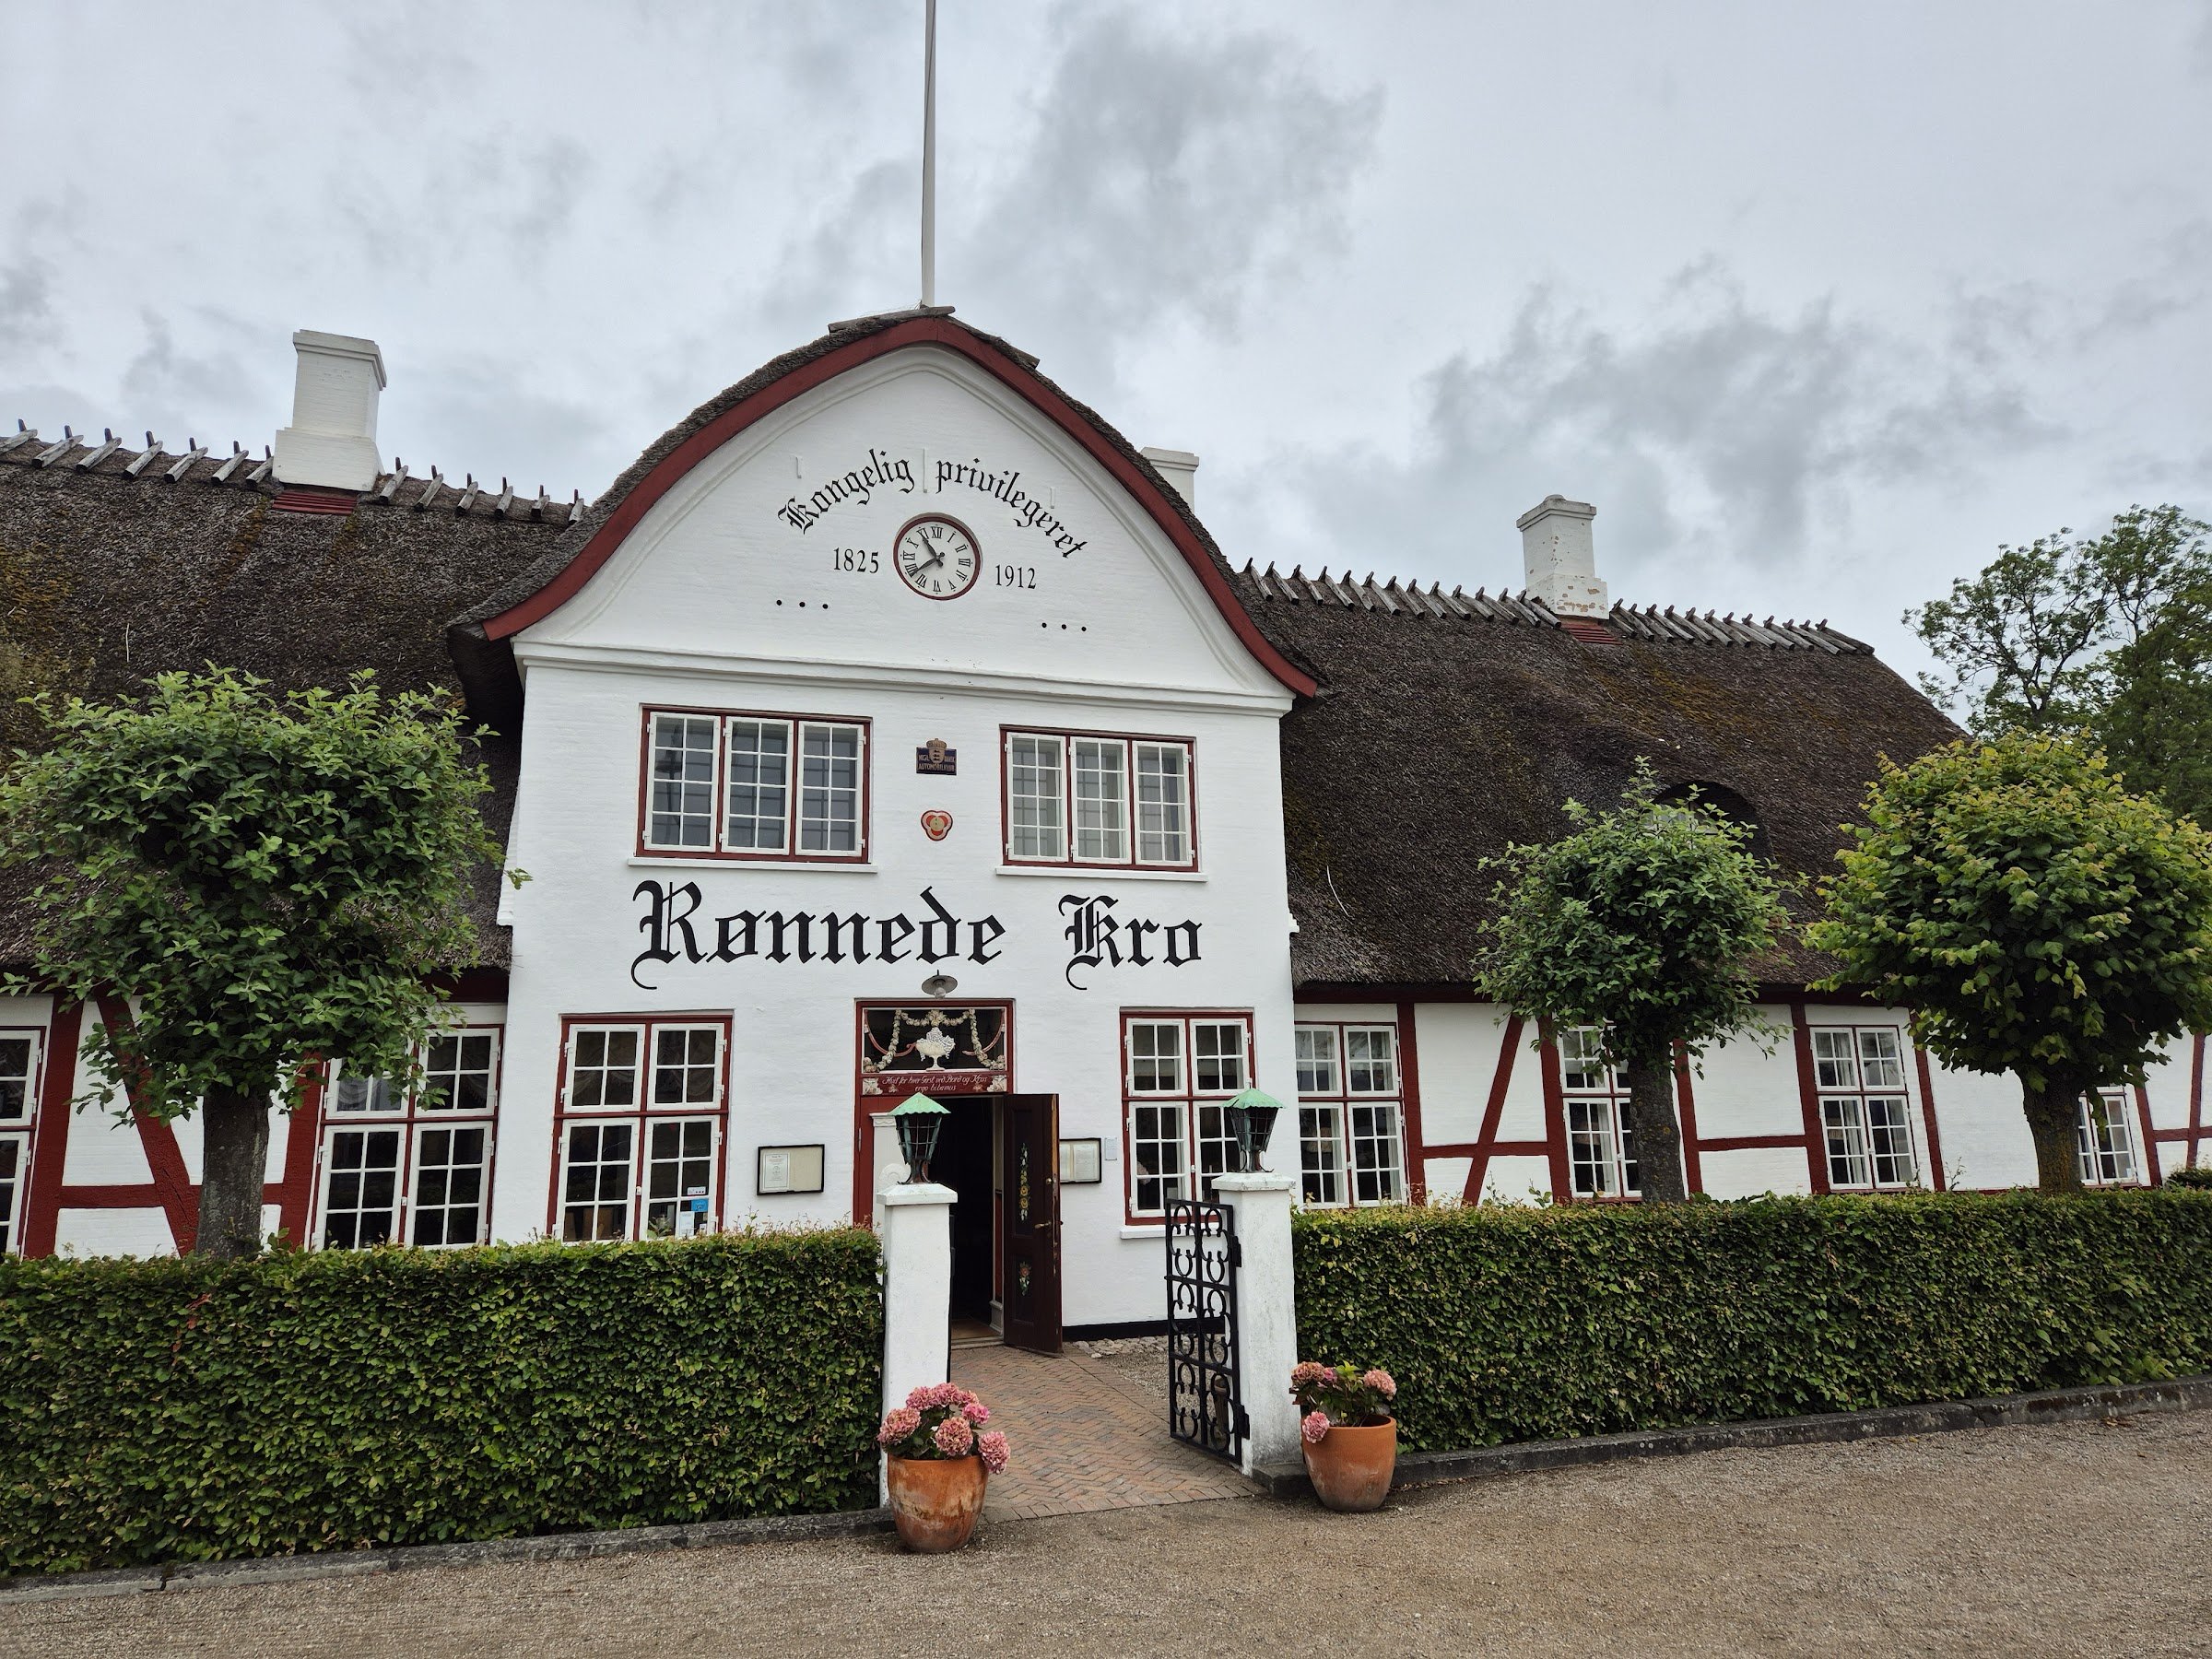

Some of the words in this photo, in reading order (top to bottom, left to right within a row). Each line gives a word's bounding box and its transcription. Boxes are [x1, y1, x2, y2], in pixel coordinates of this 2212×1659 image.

[777, 448, 915, 535] Kongelig
[935, 457, 1088, 559] privilegeret
[930, 525, 944, 539] XII
[947, 532, 956, 544] I
[906, 537, 920, 549] X
[955, 544, 968, 553] II
[833, 547, 879, 573] 1825
[903, 550, 916, 560] IX
[959, 559, 971, 568] III
[914, 573, 928, 588] VII
[995, 564, 1037, 590] 1912
[933, 580, 943, 593] VI
[947, 579, 957, 591] V
[630, 879, 1006, 991] Rønnede
[1058, 894, 1203, 991] Kro
